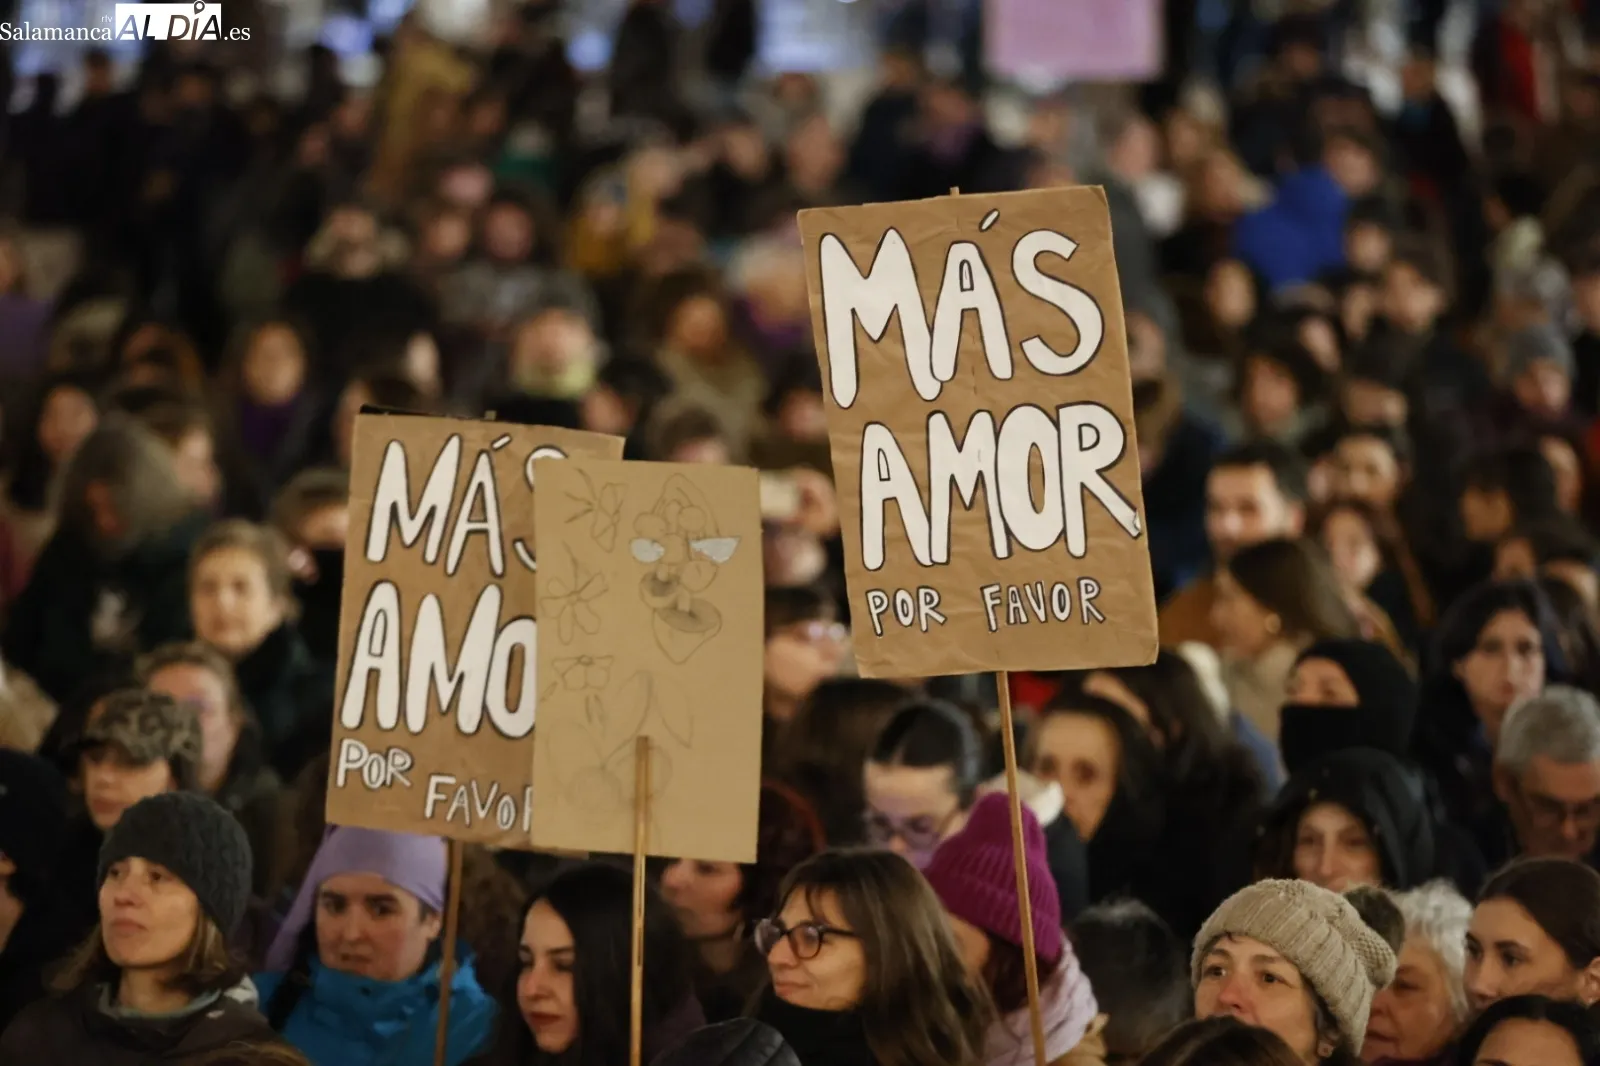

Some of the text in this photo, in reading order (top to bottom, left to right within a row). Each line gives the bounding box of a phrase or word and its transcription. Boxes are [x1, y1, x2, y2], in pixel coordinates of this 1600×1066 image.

[819, 208, 1105, 409] MÁS
[859, 401, 1142, 572] AMOR
[340, 579, 537, 739] AMO
[866, 577, 1106, 637] POR FAVOR
[336, 738, 412, 788] POR
